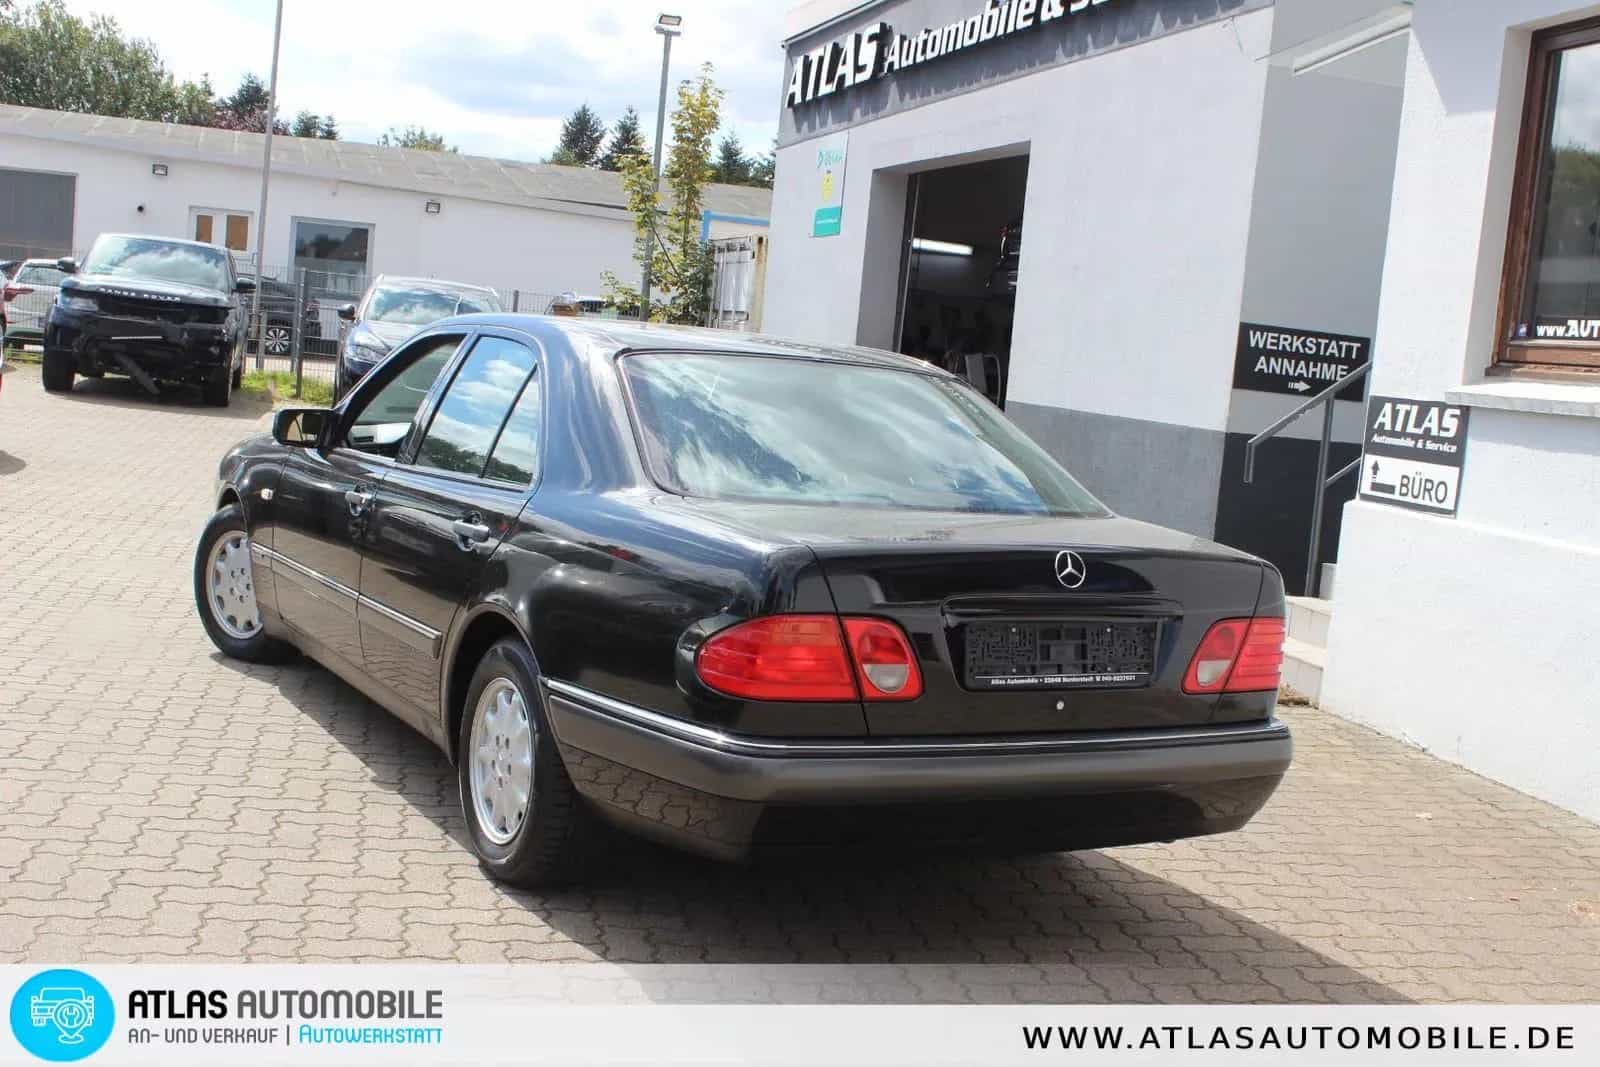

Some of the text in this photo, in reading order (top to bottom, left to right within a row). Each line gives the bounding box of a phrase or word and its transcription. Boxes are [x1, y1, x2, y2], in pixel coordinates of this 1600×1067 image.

[785, 23, 881, 108] ATLAS
[884, 0, 1037, 74] Automobile
[1249, 329, 1361, 360] WERKSTATT
[1254, 355, 1349, 382] ANNAHME
[1373, 402, 1461, 438] ATLAS
[1425, 440, 1457, 453] Service
[1399, 471, 1448, 504] BÜRO
